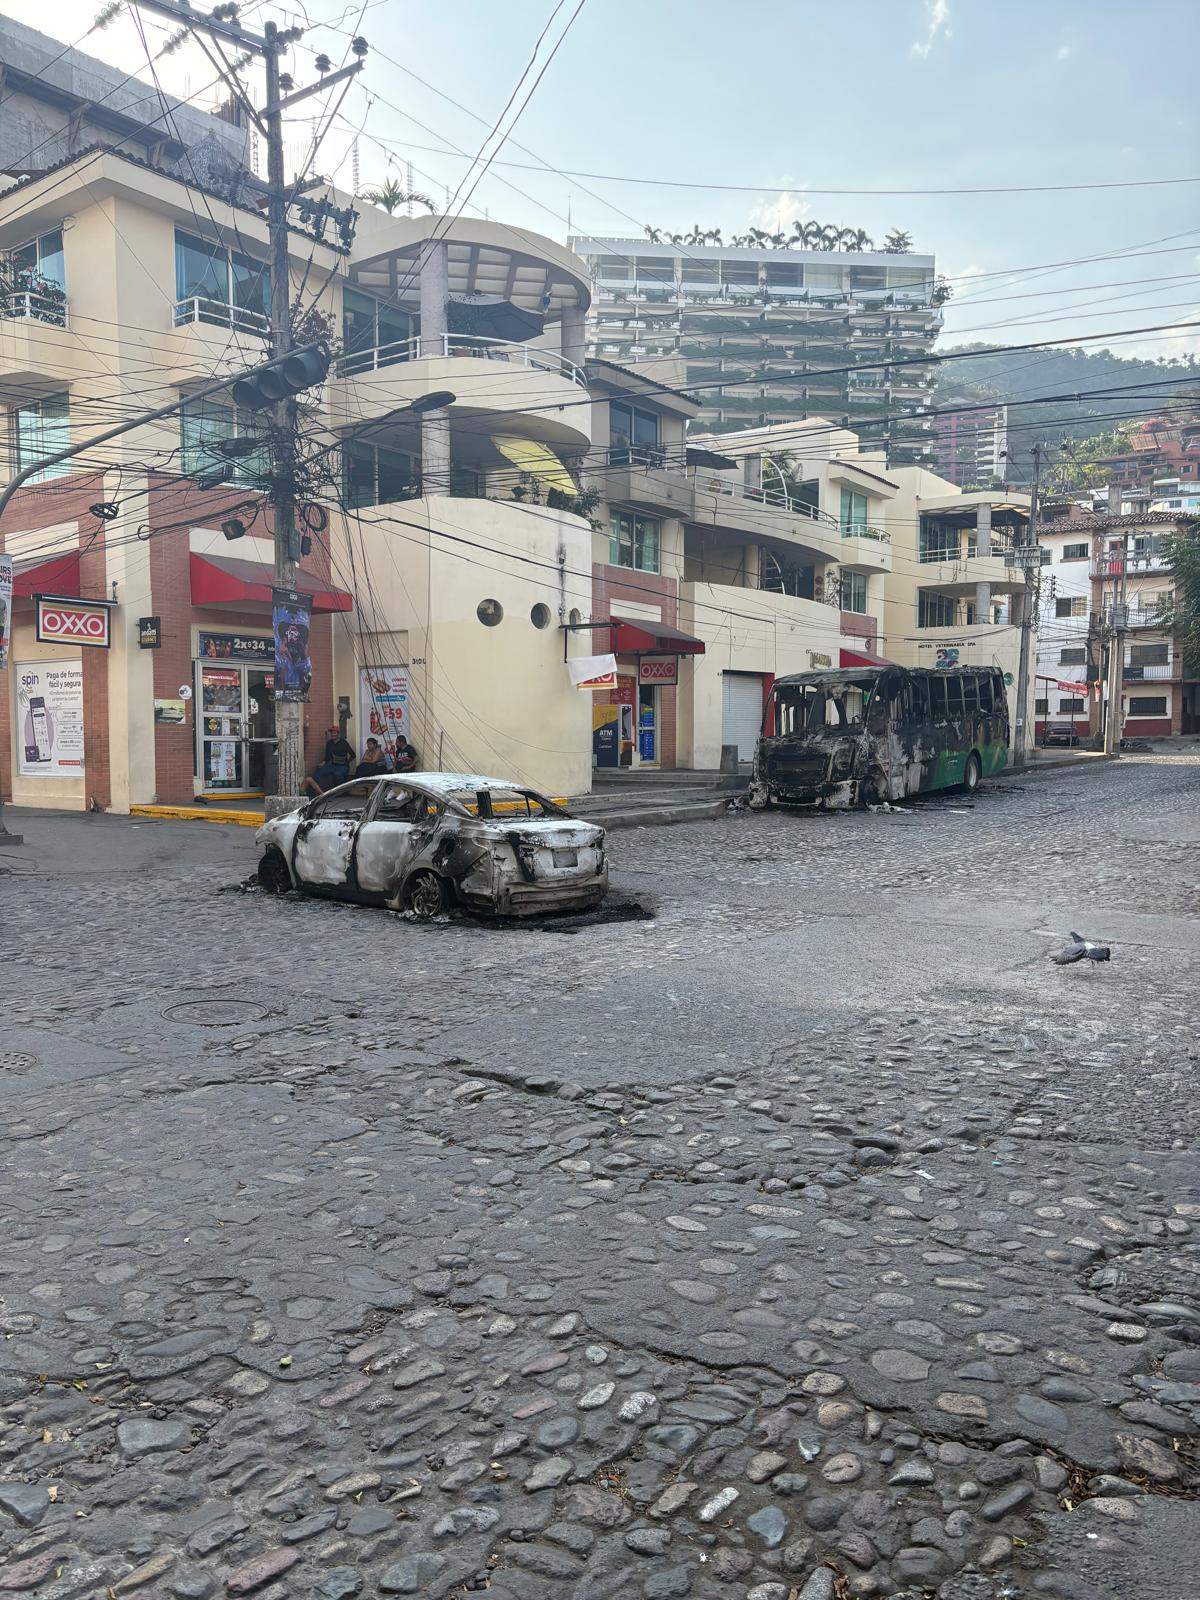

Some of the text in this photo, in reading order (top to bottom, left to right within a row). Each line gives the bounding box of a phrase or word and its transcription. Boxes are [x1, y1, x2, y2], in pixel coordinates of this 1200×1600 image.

[43, 612, 104, 635] OXXO
[46, 672, 60, 680] Paga
[641, 662, 675, 679] OXXO
[21, 674, 40, 687] spin
[64, 680, 81, 689] segura
